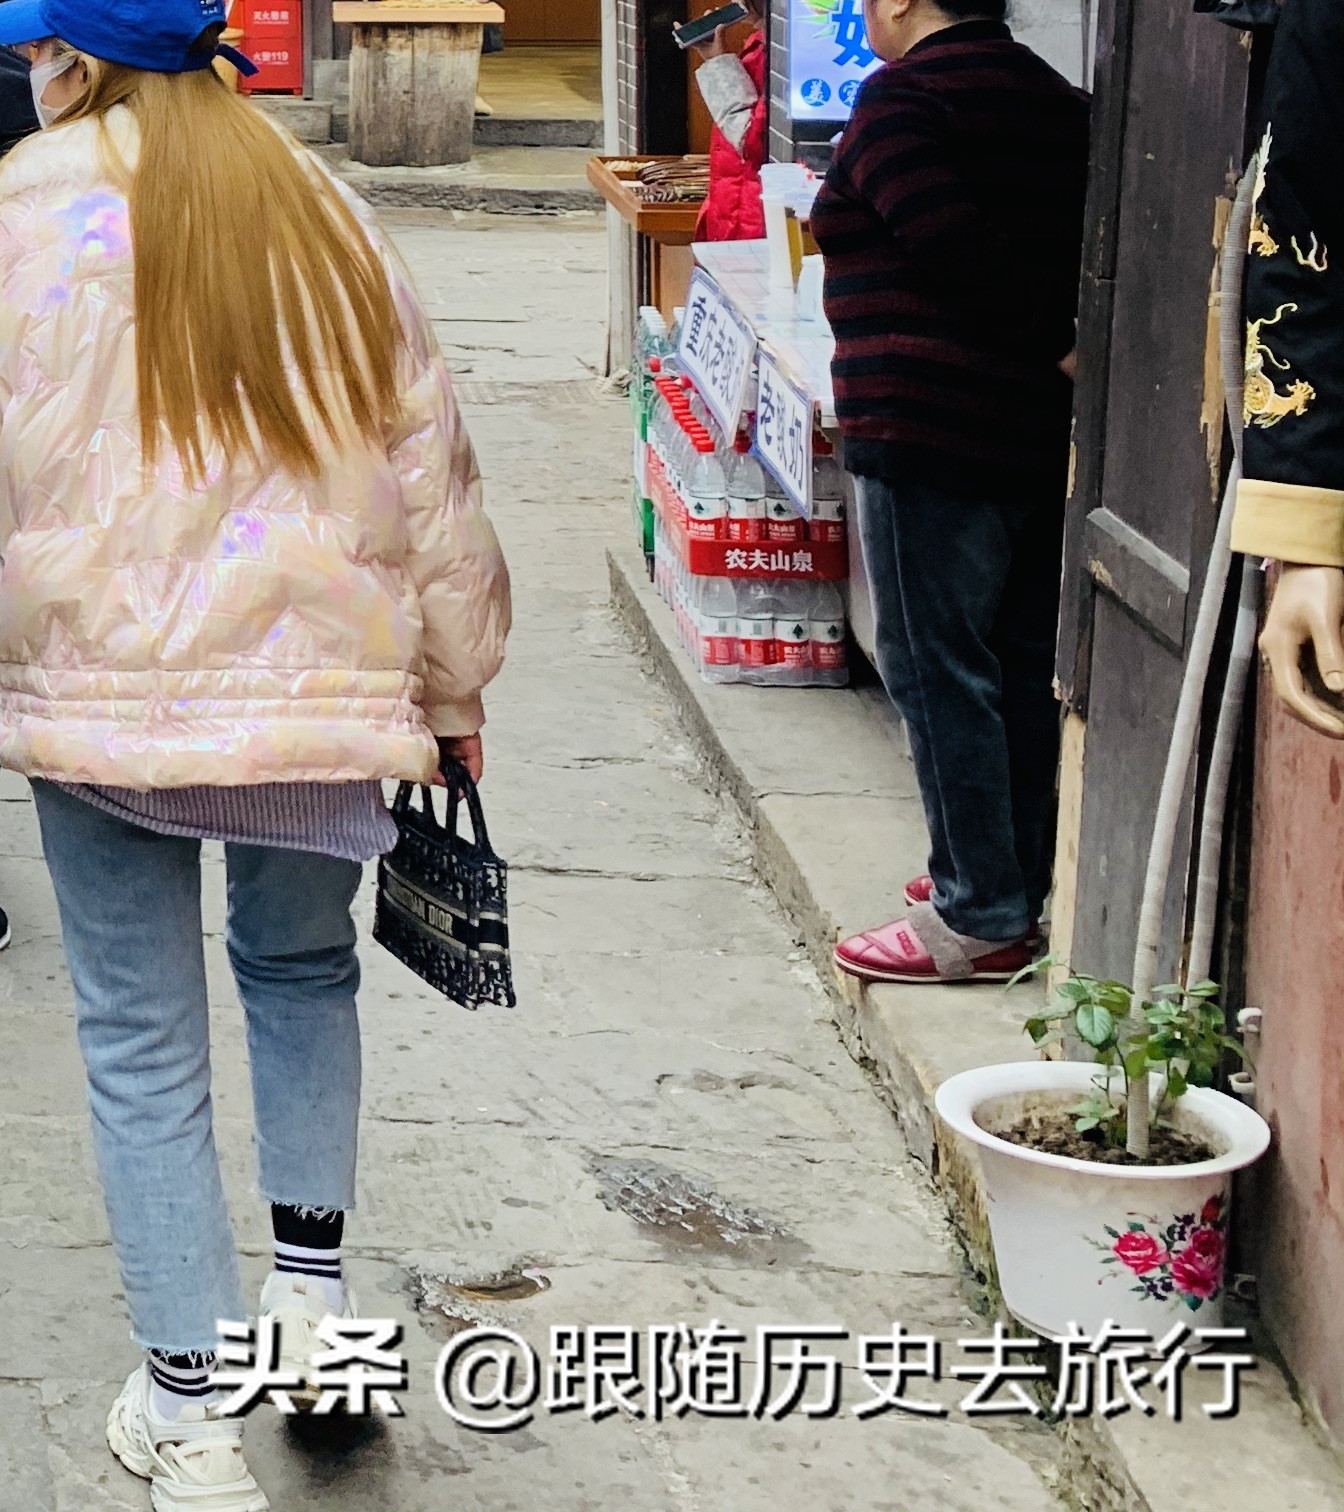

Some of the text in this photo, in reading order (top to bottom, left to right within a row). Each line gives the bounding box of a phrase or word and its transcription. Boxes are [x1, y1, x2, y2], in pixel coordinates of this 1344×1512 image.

[725, 548, 814, 573] 农夫山泉
[427, 903, 454, 938] DIOR
